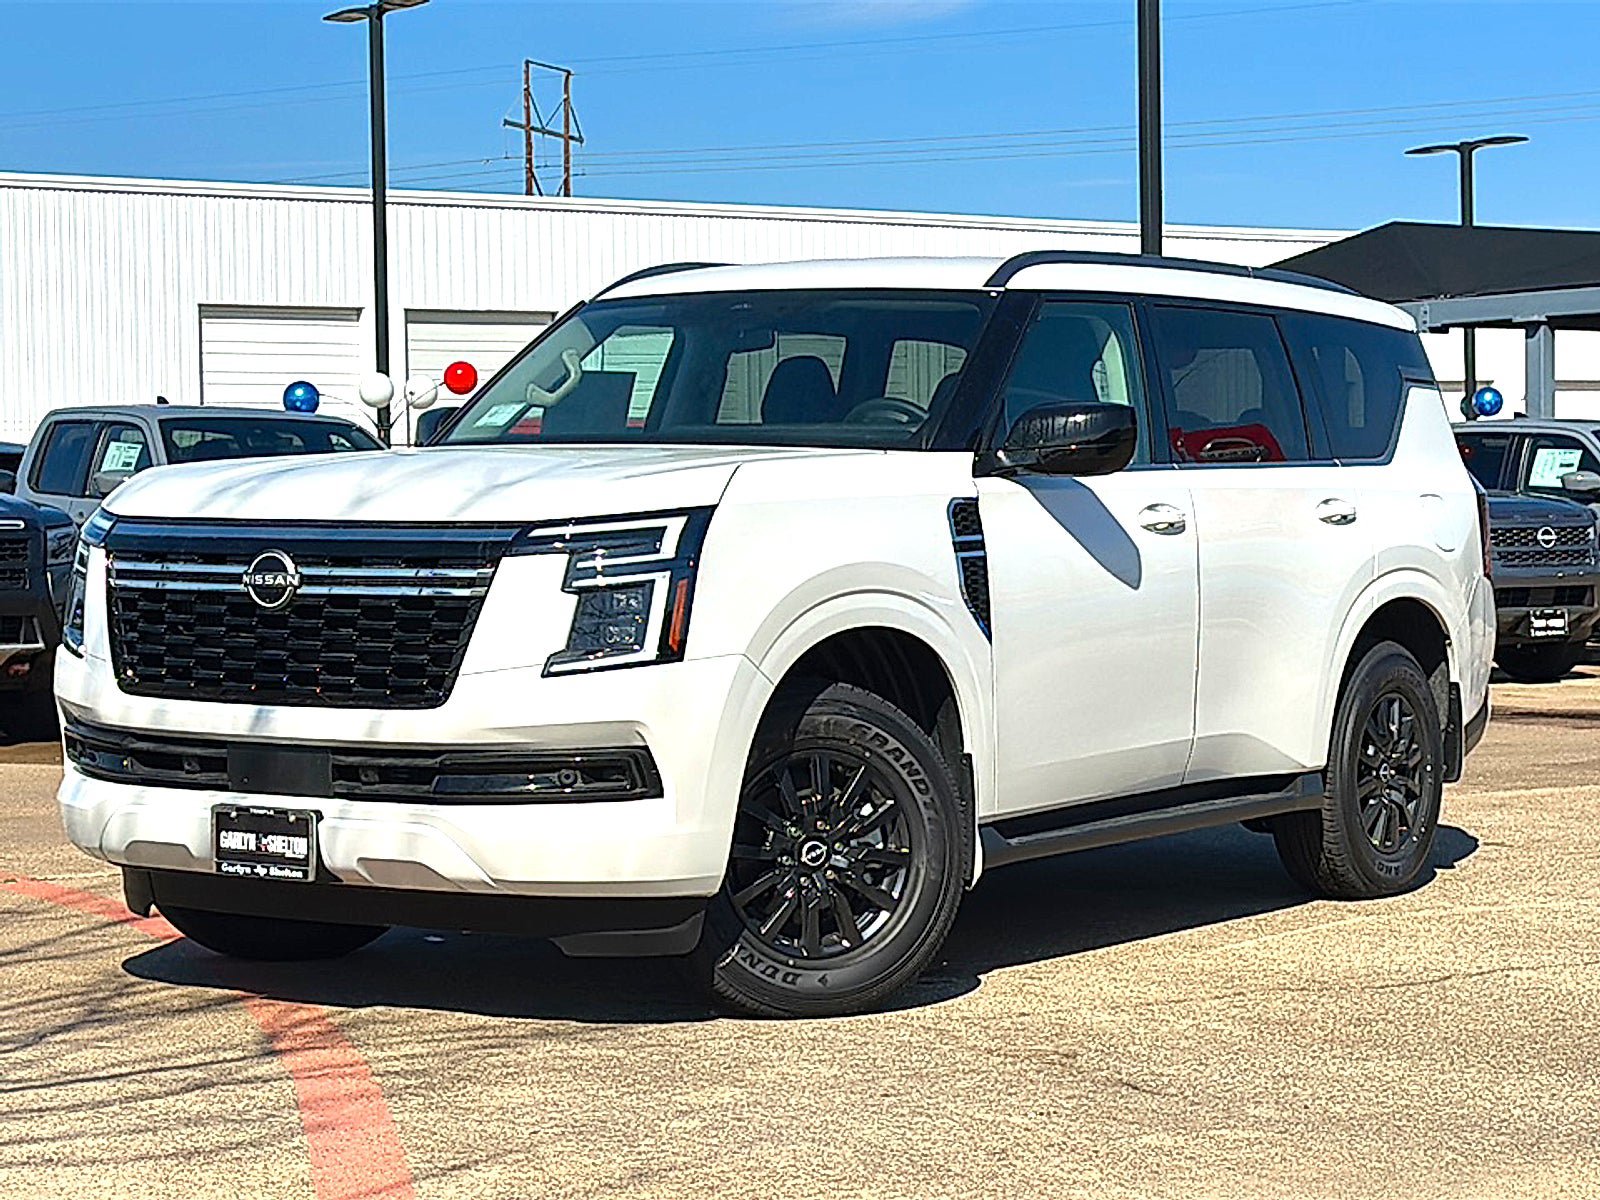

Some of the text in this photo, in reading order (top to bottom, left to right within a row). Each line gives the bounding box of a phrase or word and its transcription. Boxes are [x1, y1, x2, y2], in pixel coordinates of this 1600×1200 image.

[242, 574, 301, 586] NISSAN
[267, 834, 308, 855] SHELTON
[739, 950, 802, 986] DUN
